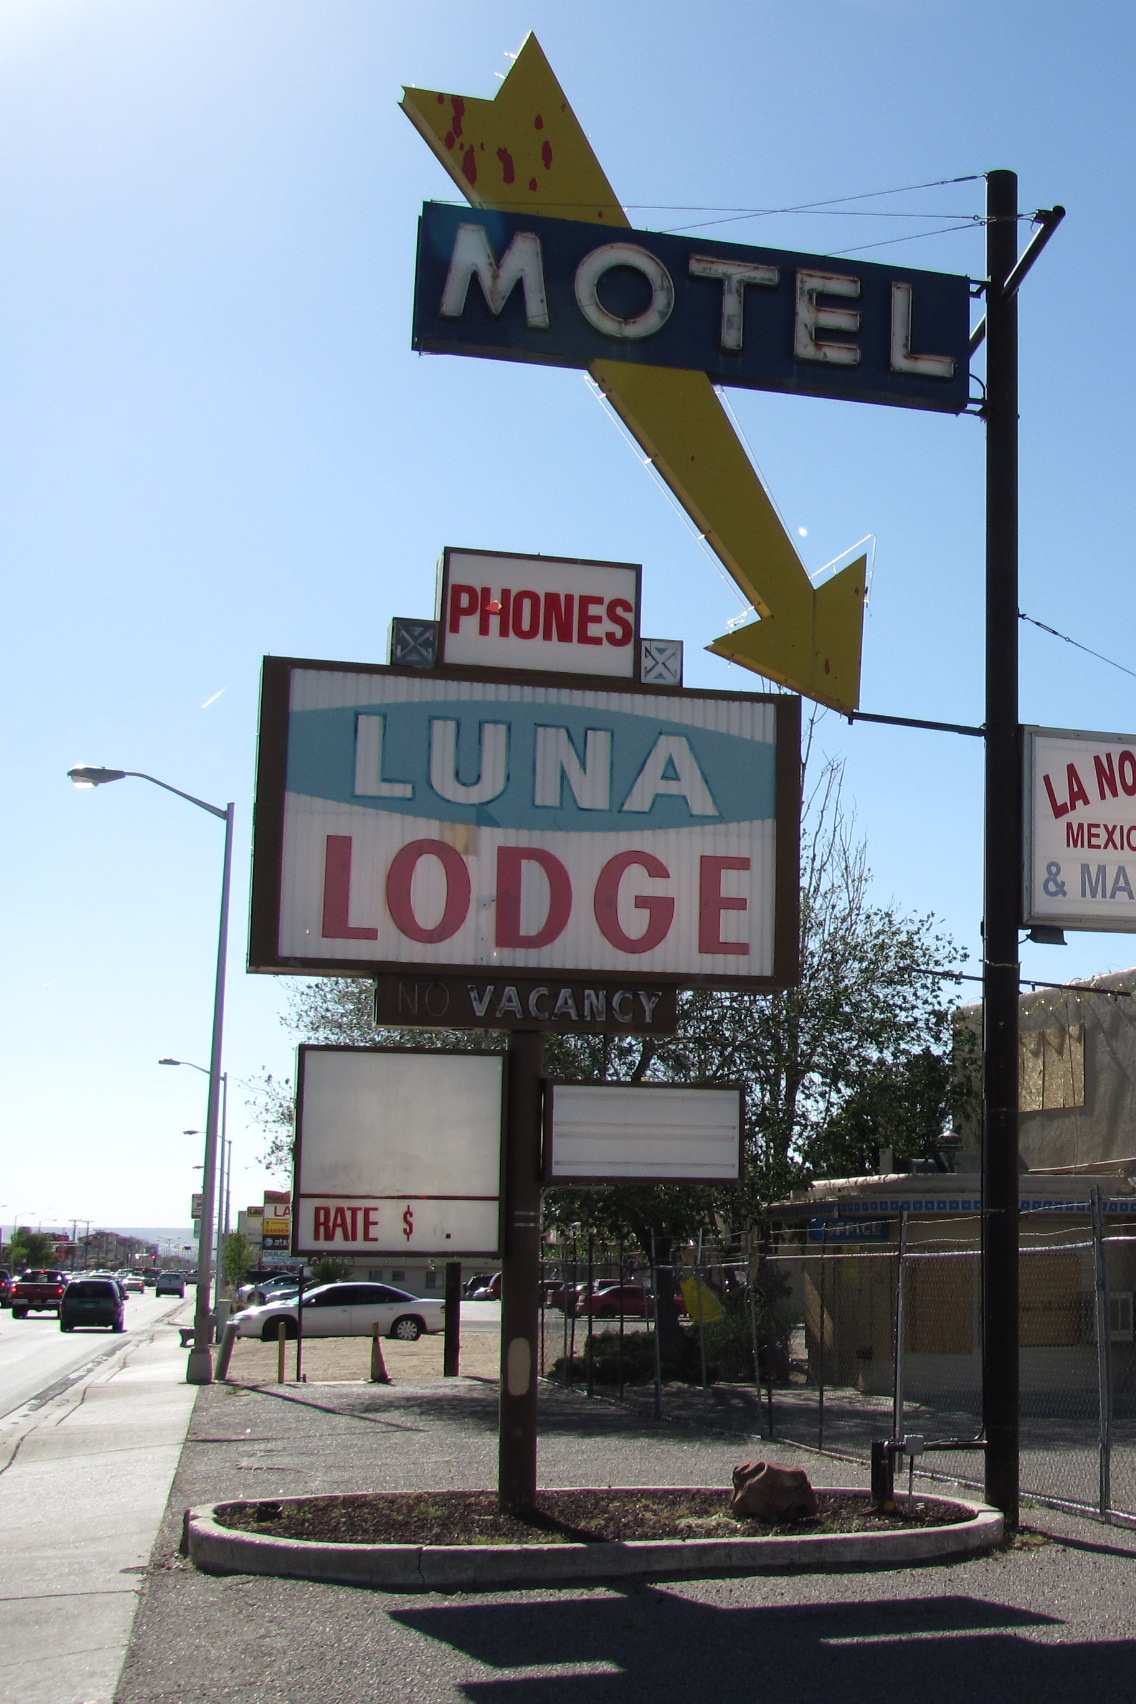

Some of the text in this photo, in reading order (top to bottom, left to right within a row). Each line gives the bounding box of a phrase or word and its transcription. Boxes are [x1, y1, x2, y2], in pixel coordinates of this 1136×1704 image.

[439, 222, 956, 378] MOTEL
[449, 583, 634, 648] PHONES
[352, 710, 721, 819] LUNA
[1043, 762, 1091, 819] LA
[321, 834, 751, 955] LODGE
[1042, 861, 1068, 898] &
[467, 984, 663, 1023] VACANCY
[313, 1204, 414, 1242] RATE $
[824, 1221, 881, 1236] OFFICE
